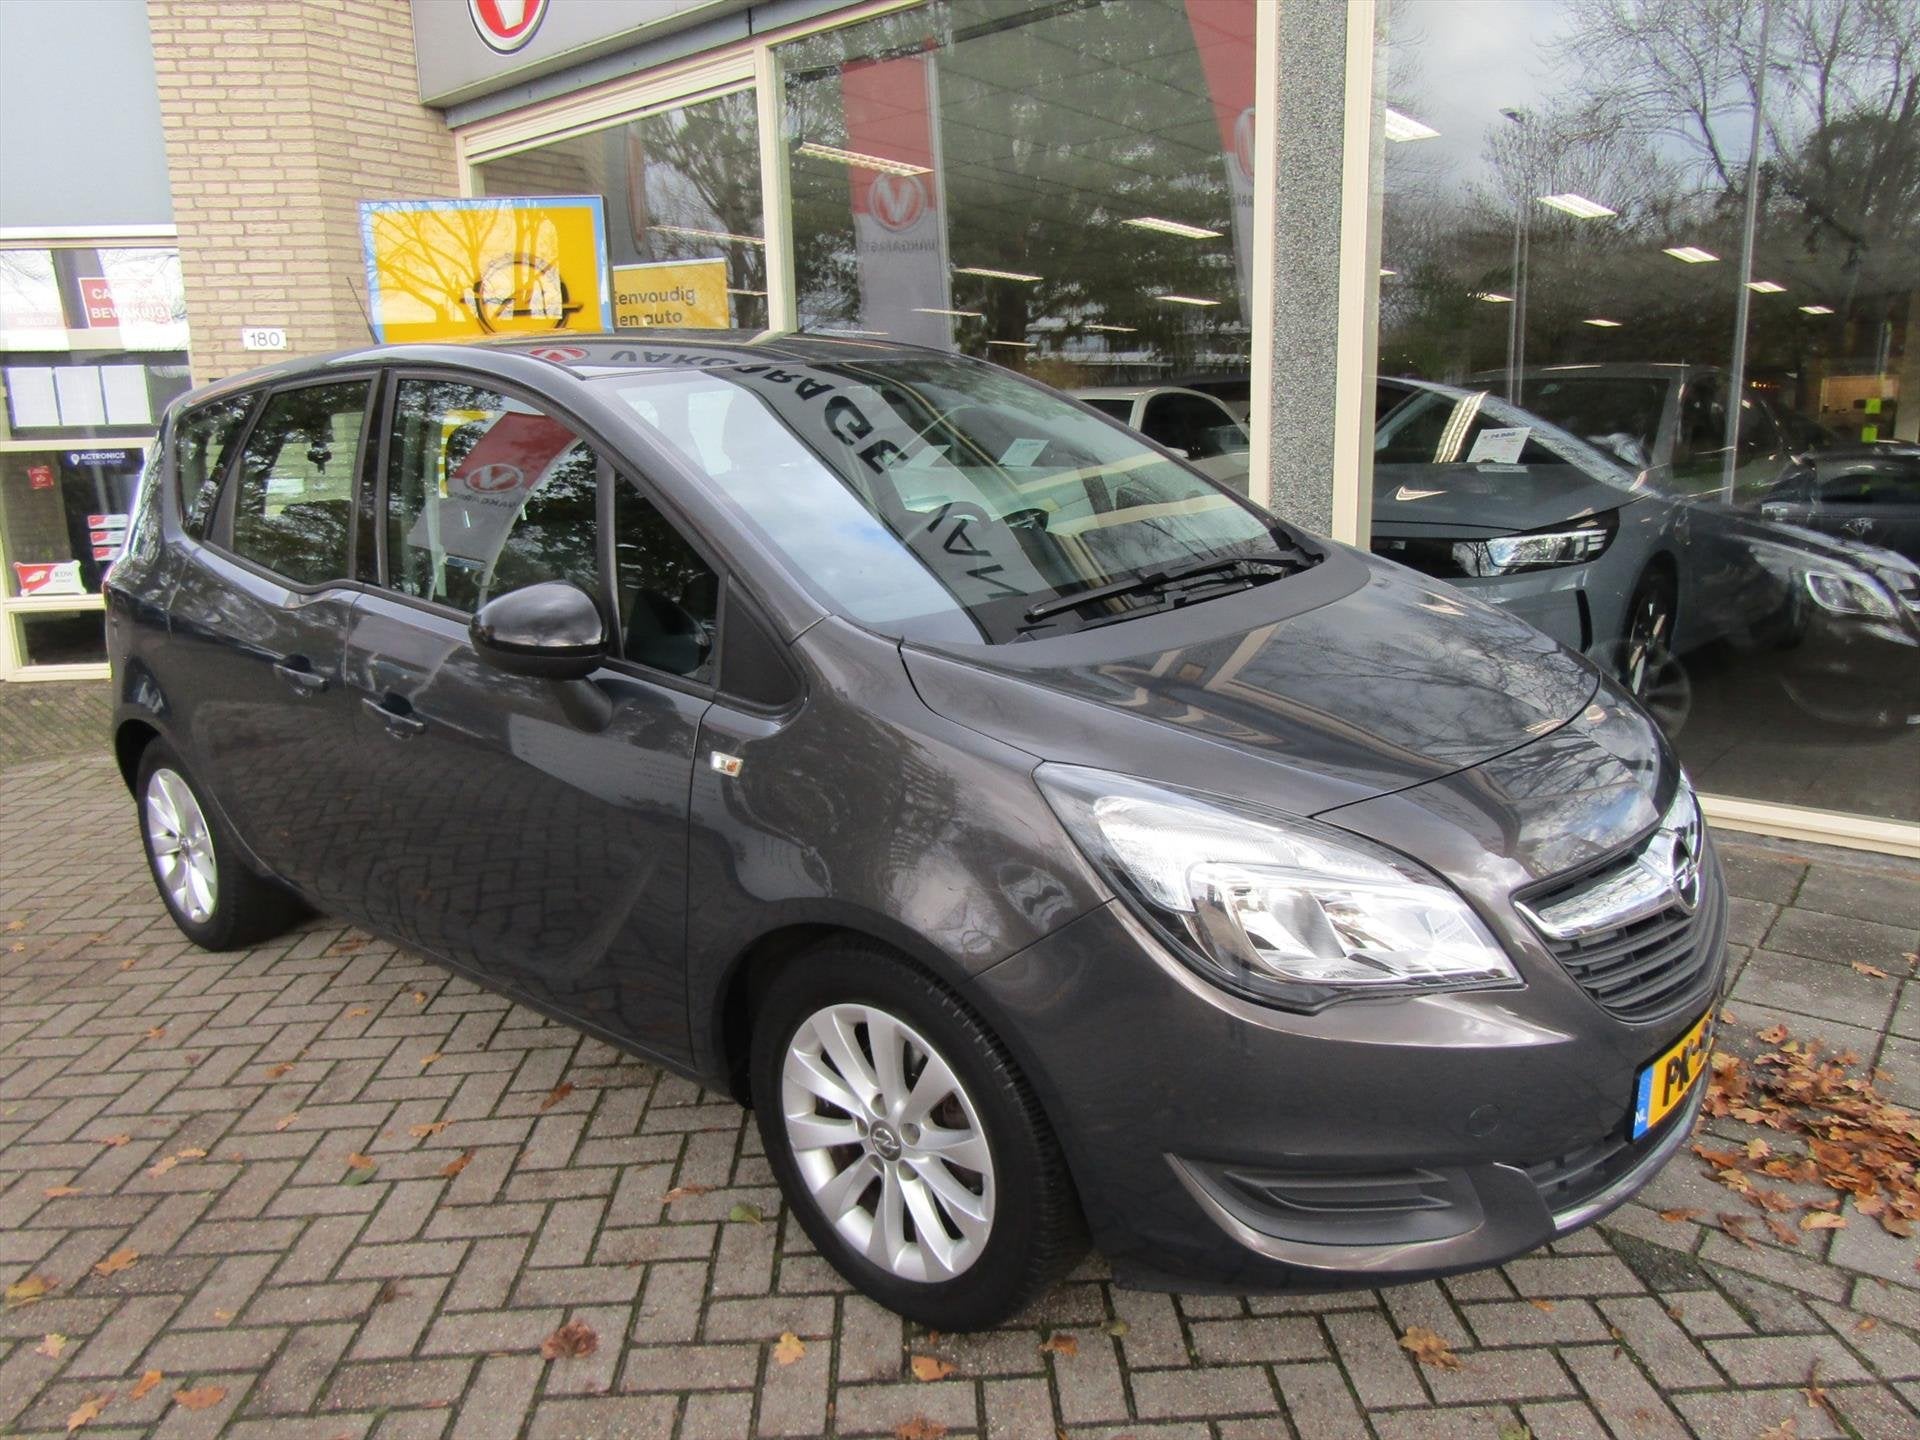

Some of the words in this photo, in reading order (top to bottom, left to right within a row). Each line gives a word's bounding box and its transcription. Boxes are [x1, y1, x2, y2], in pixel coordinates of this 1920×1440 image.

[614, 314, 639, 326] en
[643, 310, 683, 325] auto
[250, 332, 280, 347] 180
[80, 452, 125, 460] ACTRONICS
